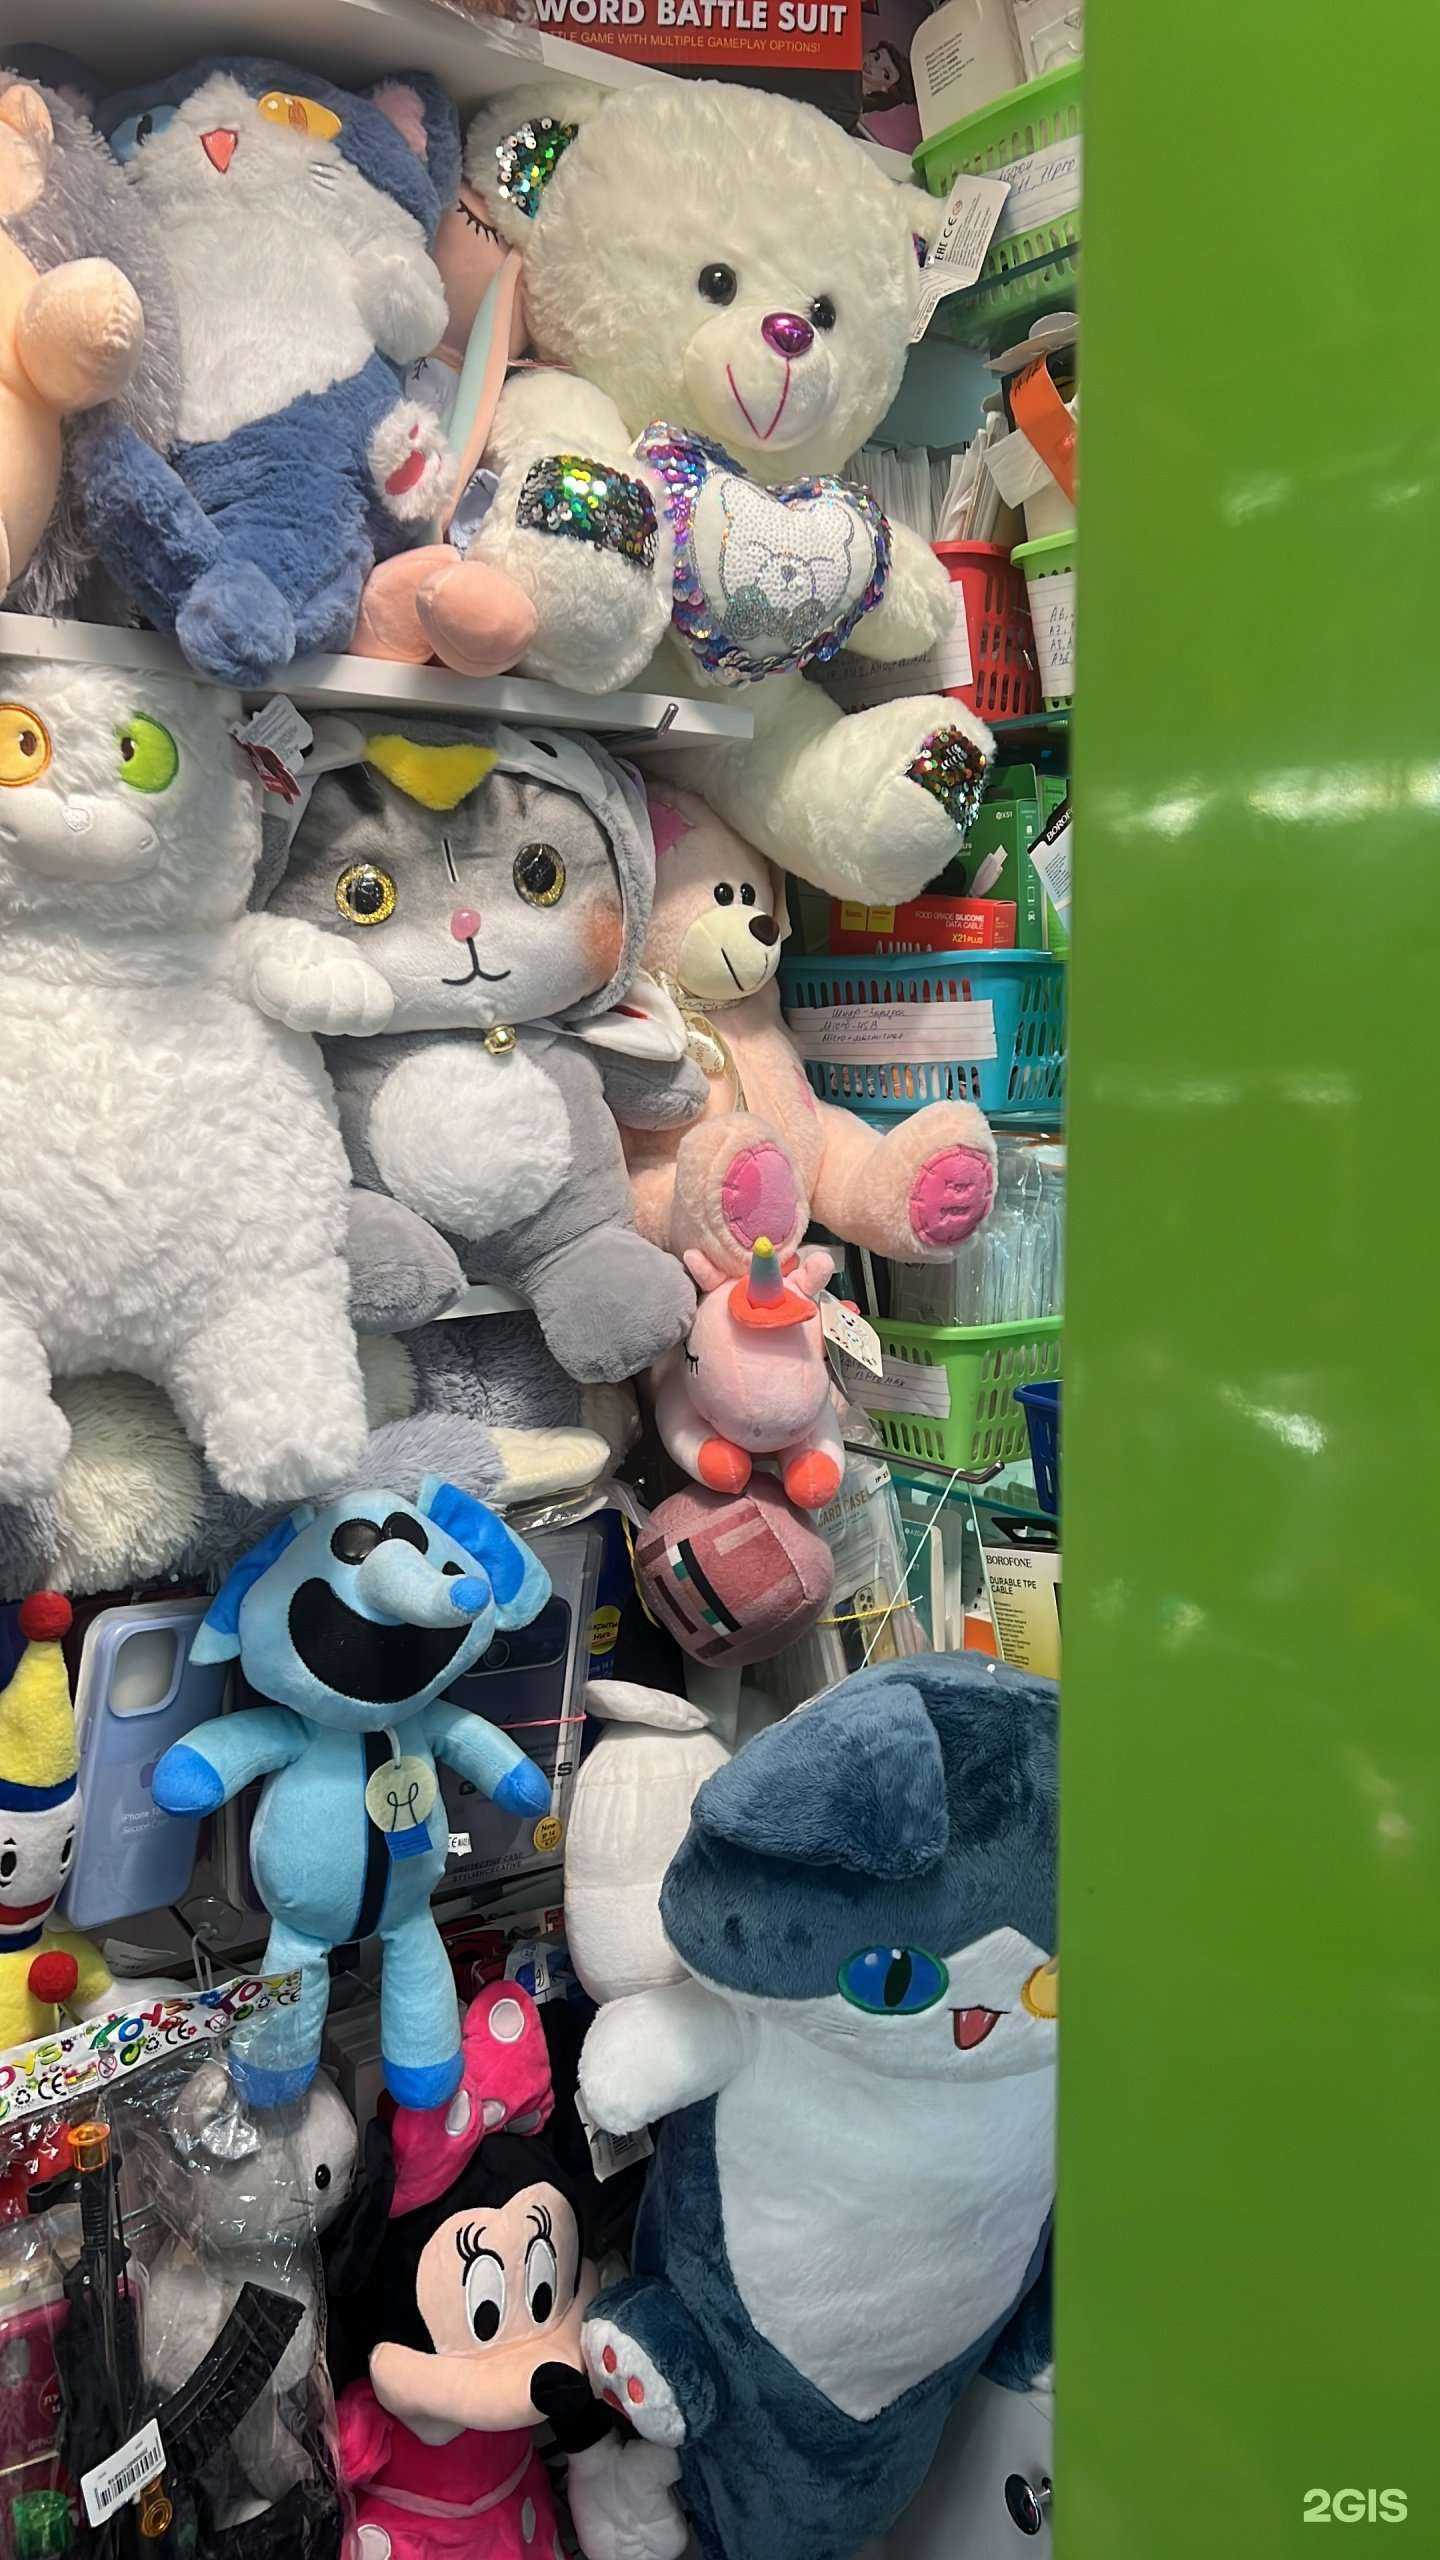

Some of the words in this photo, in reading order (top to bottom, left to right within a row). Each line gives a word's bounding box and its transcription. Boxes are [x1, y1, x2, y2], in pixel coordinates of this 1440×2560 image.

[657, 0, 768, 29] BATTLE
[778, 1, 848, 33] SUIT
[580, 32, 614, 44] GAME
[617, 33, 647, 45] WITH
[650, 35, 705, 47] MULTIPLE
[707, 36, 767, 50] GAMEPLAY
[769, 39, 821, 53] OPTIONS!
[945, 921, 963, 929] DATA
[963, 921, 984, 930] CABLE
[952, 933, 967, 943] X21
[984, 1555, 1033, 1569] BOROFONE
[989, 1576, 1022, 1589] DURABLE
[1022, 1580, 1037, 1589] TPE
[991, 1585, 1014, 1595] CABLE
